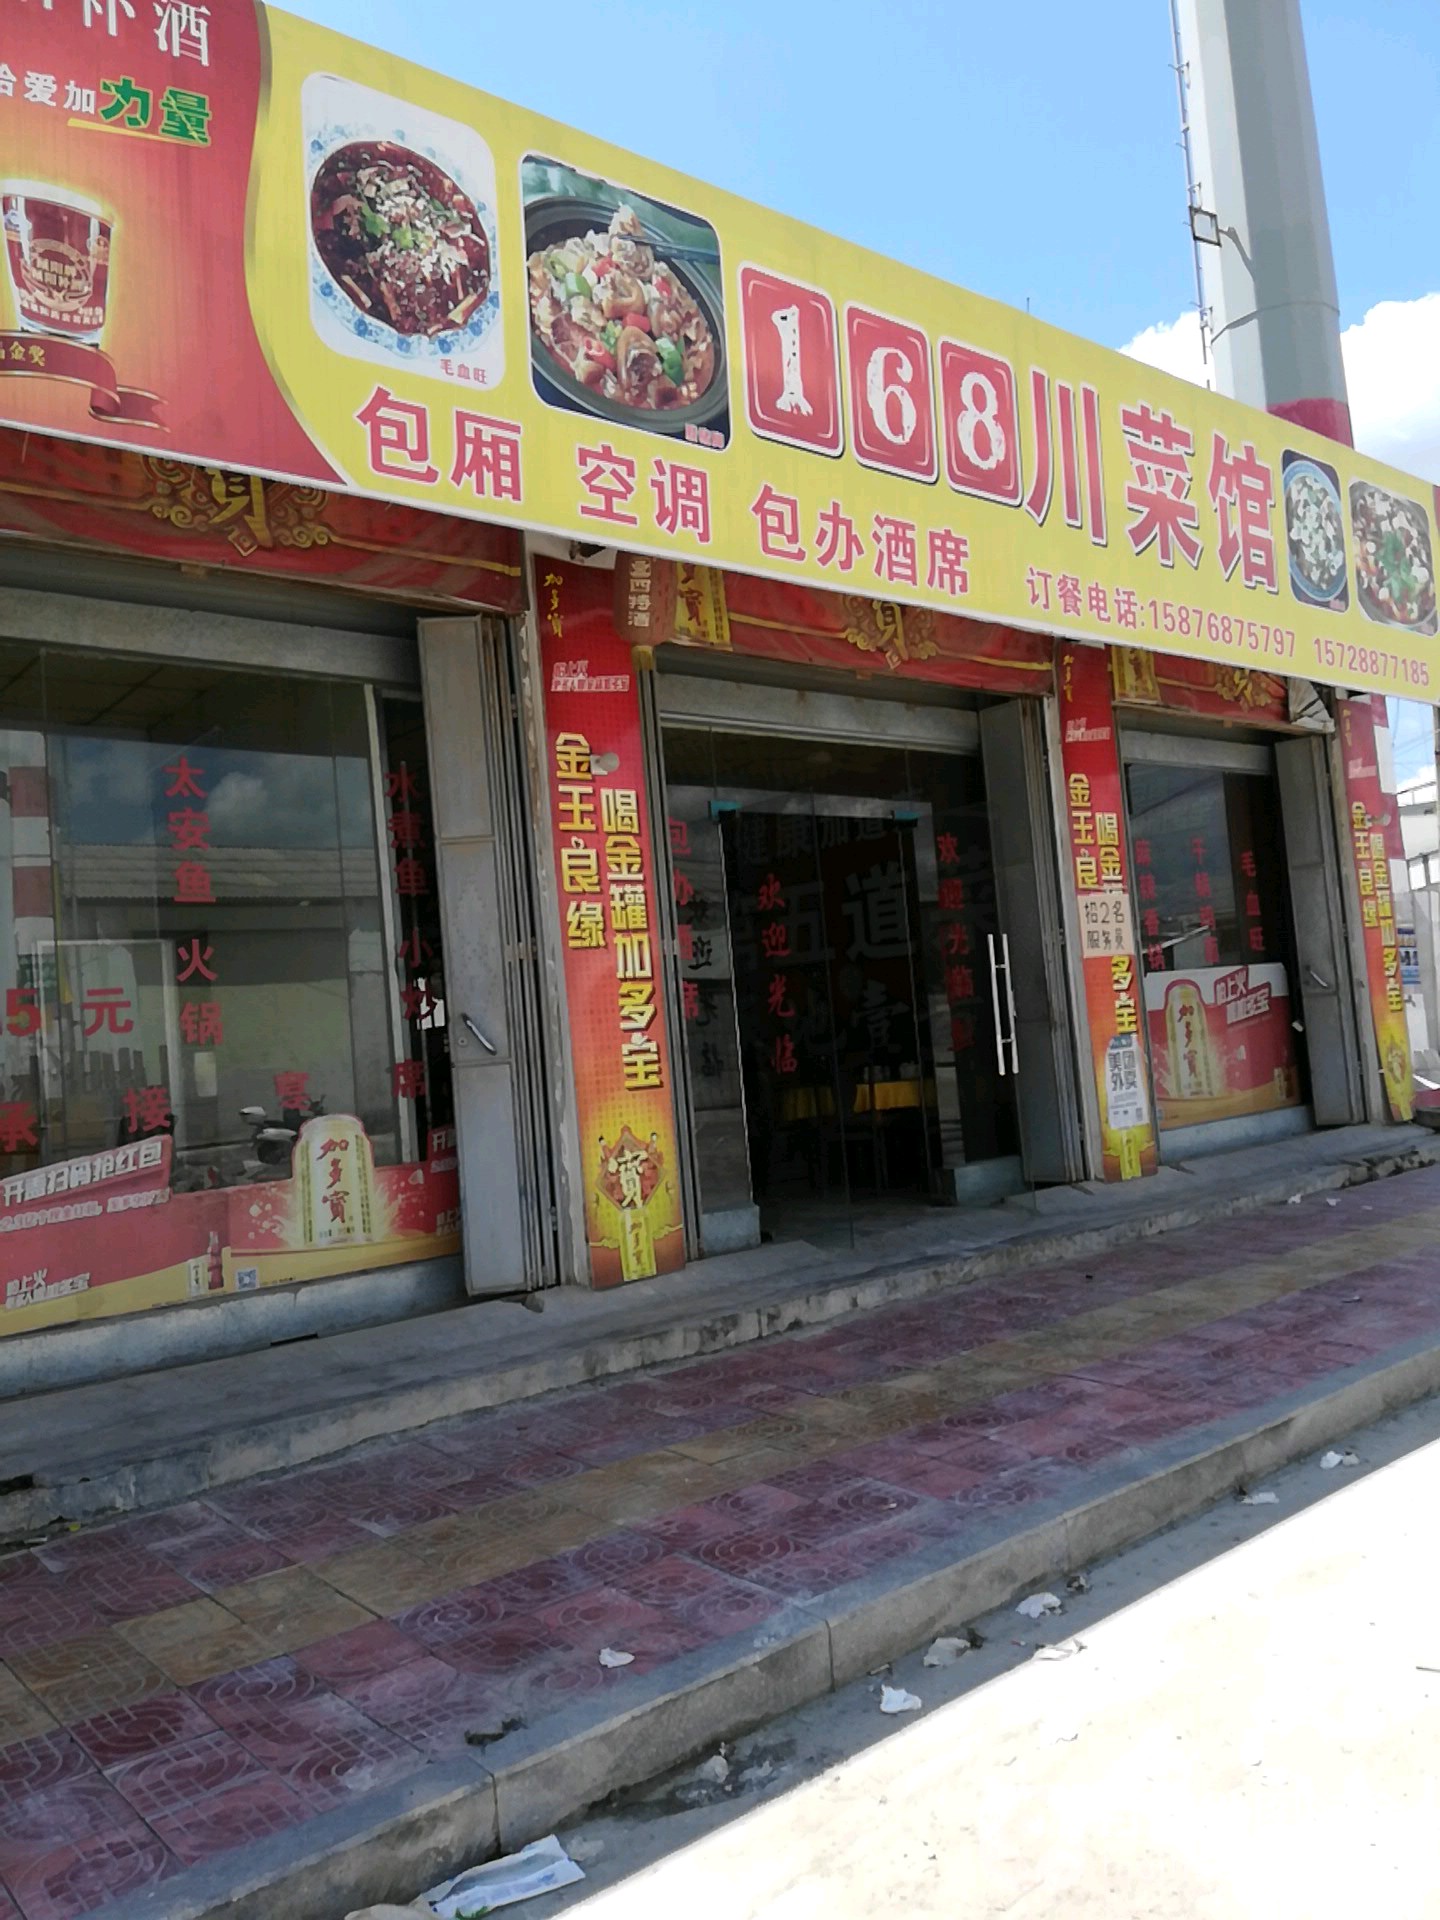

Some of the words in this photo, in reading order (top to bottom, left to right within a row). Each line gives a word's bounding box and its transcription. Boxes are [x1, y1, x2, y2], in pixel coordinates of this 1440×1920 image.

[0, 341, 46, 367] 金奖
[439, 358, 488, 386] 毛血旺
[773, 303, 1279, 592] 168川菜馆
[356, 386, 524, 502] 包厢
[577, 443, 712, 544] 空调
[750, 484, 970, 597] 包办酒席
[1026, 566, 1296, 659] 订餐电话:15876875797
[1313, 637, 1430, 687] 15728877185
[165, 757, 224, 1046] 太安鱼火锅
[385, 762, 430, 897] 水煮鱼
[555, 731, 606, 949] 金玉良缘
[1068, 773, 1099, 891] 金玉良
[1084, 900, 1125, 924] 招2名
[1095, 811, 1138, 1035] 喝金多宝
[600, 787, 663, 1090] 喝金罐加多宝
[757, 872, 799, 1075] 欢迎光临
